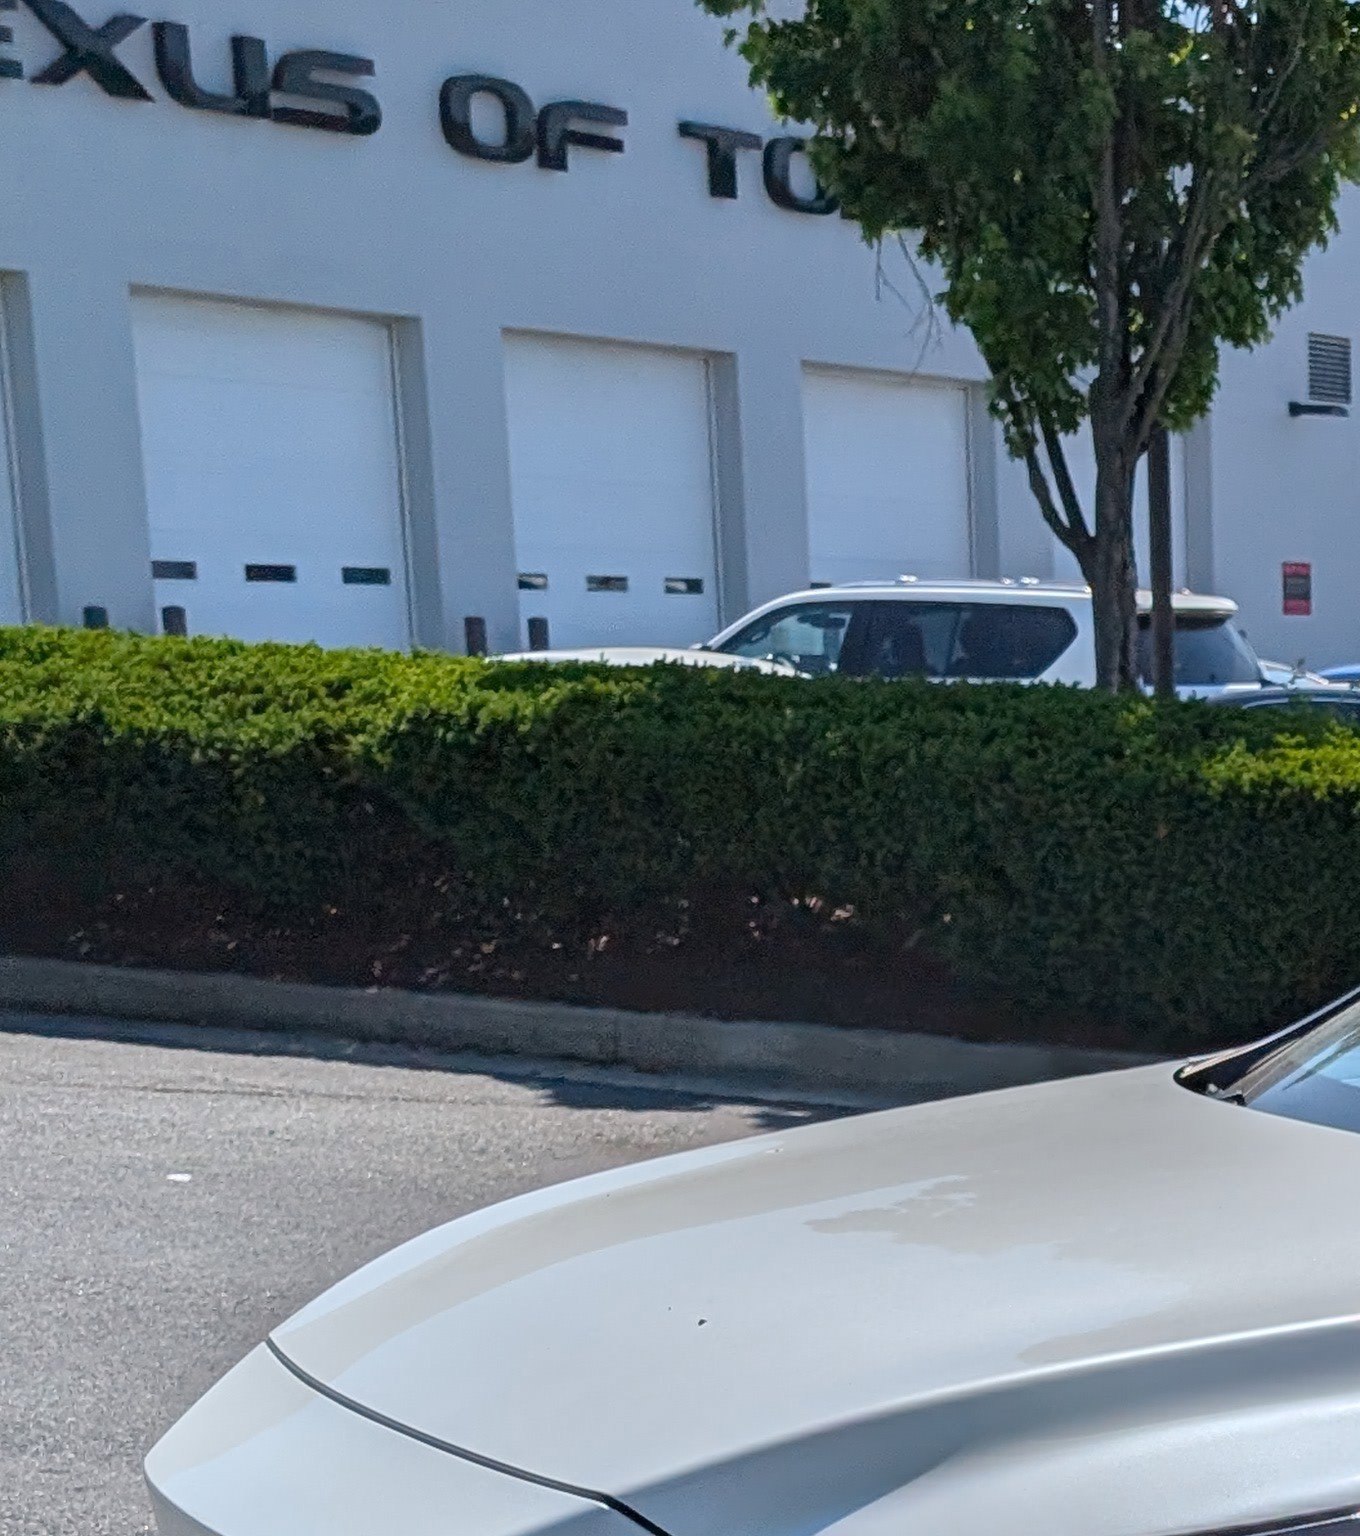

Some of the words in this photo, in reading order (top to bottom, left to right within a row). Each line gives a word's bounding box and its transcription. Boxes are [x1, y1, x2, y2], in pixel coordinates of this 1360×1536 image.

[0, 0, 382, 135] XUS
[438, 74, 628, 172] OF
[678, 119, 854, 219] TO
